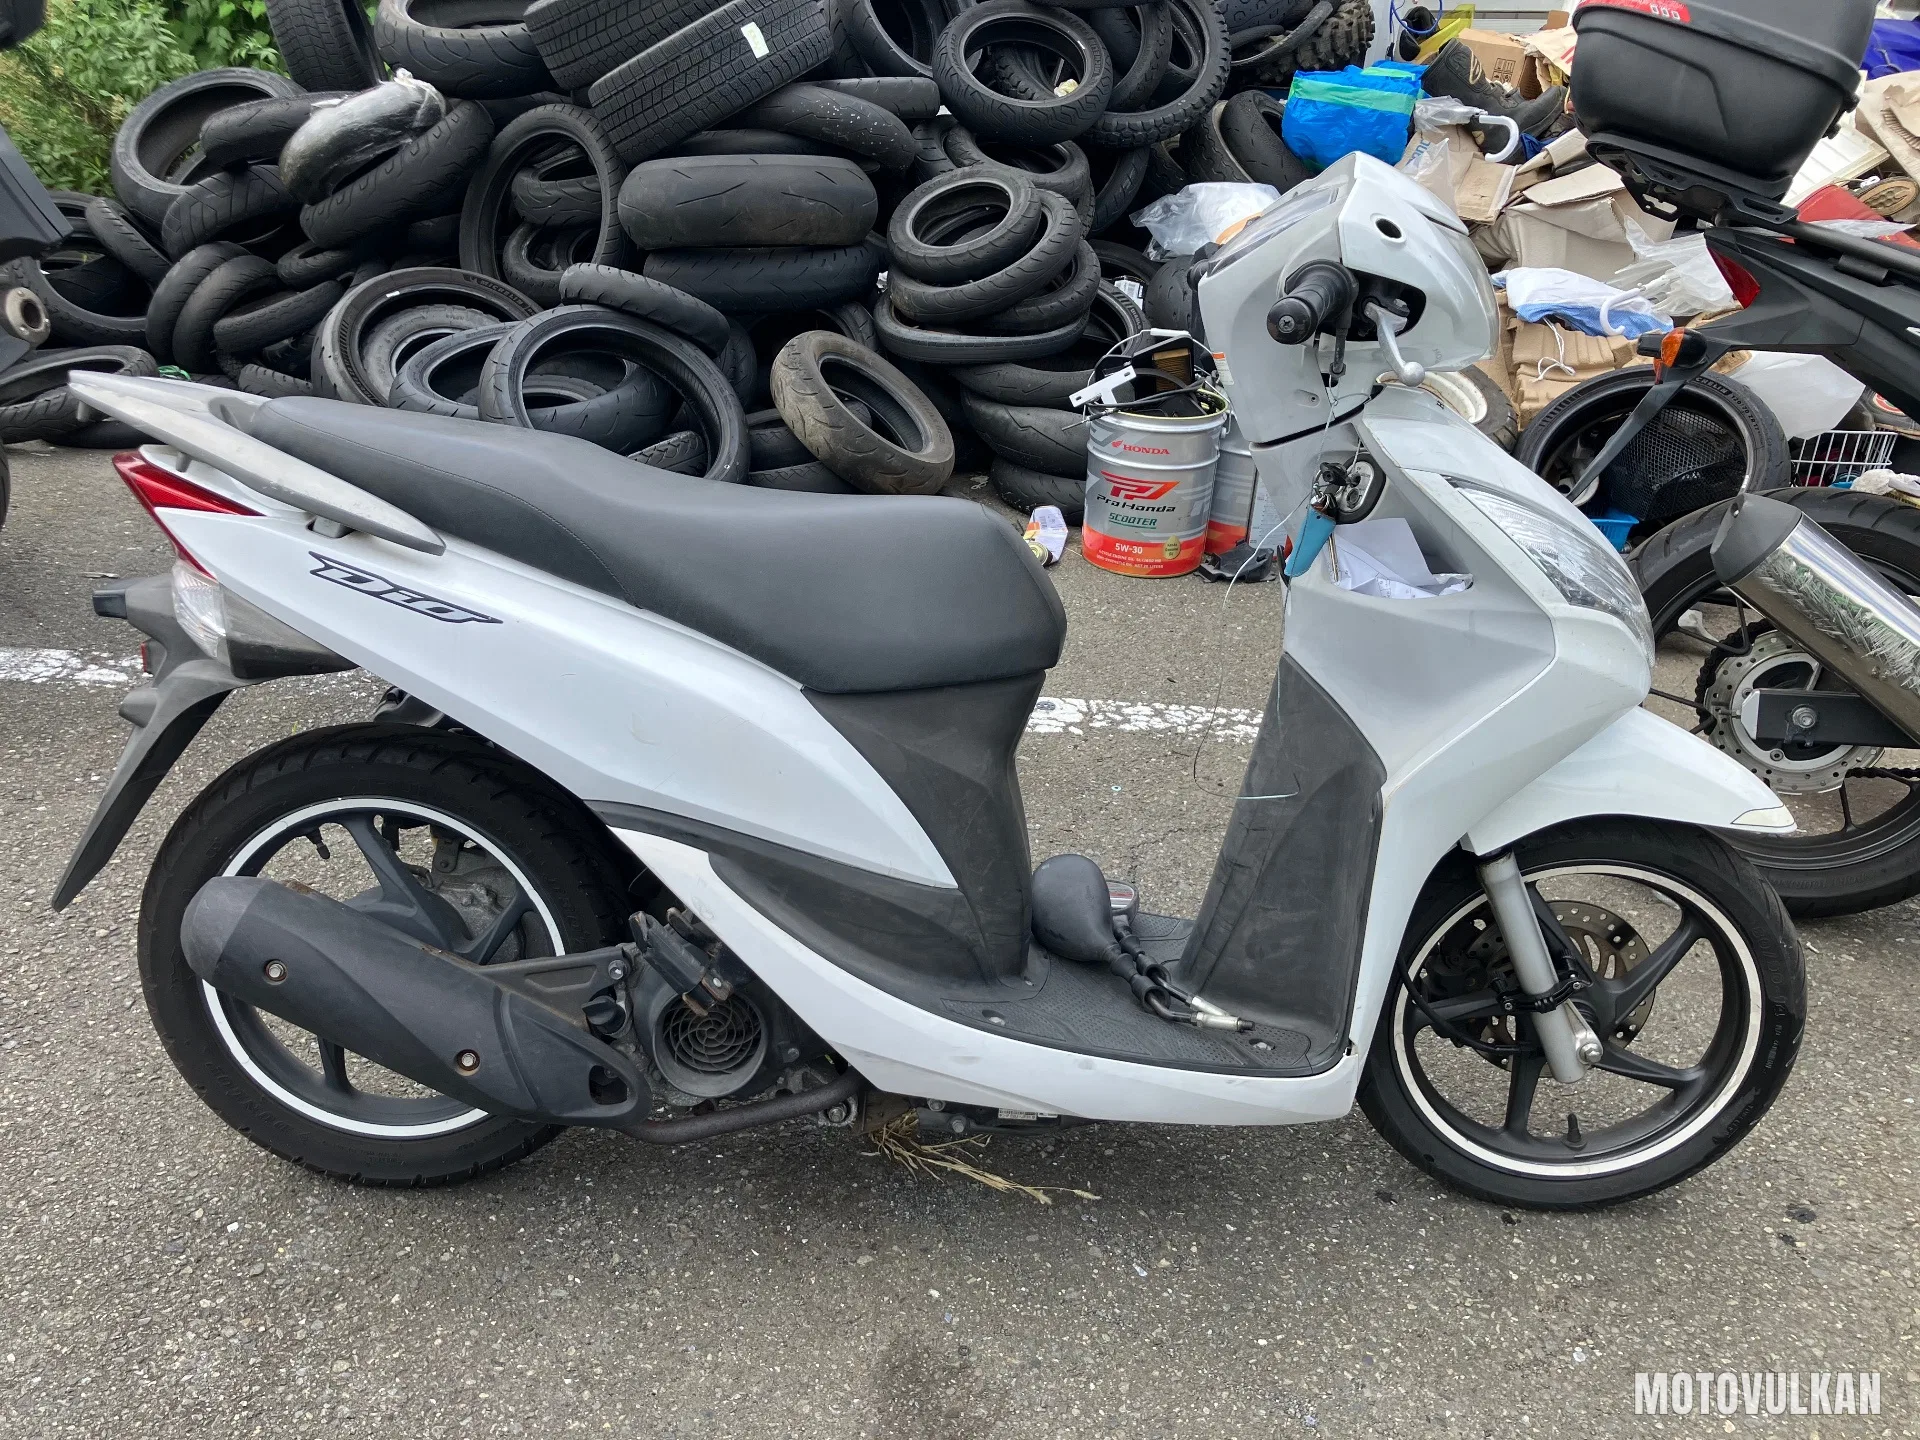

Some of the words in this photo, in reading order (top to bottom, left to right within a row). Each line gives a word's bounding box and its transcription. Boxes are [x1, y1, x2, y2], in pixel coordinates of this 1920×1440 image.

[479, 279, 525, 306] MICHELIN
[1123, 444, 1170, 455] HONDA
[1108, 512, 1158, 526] SCOOTER
[1115, 542, 1143, 555] 5W-30
